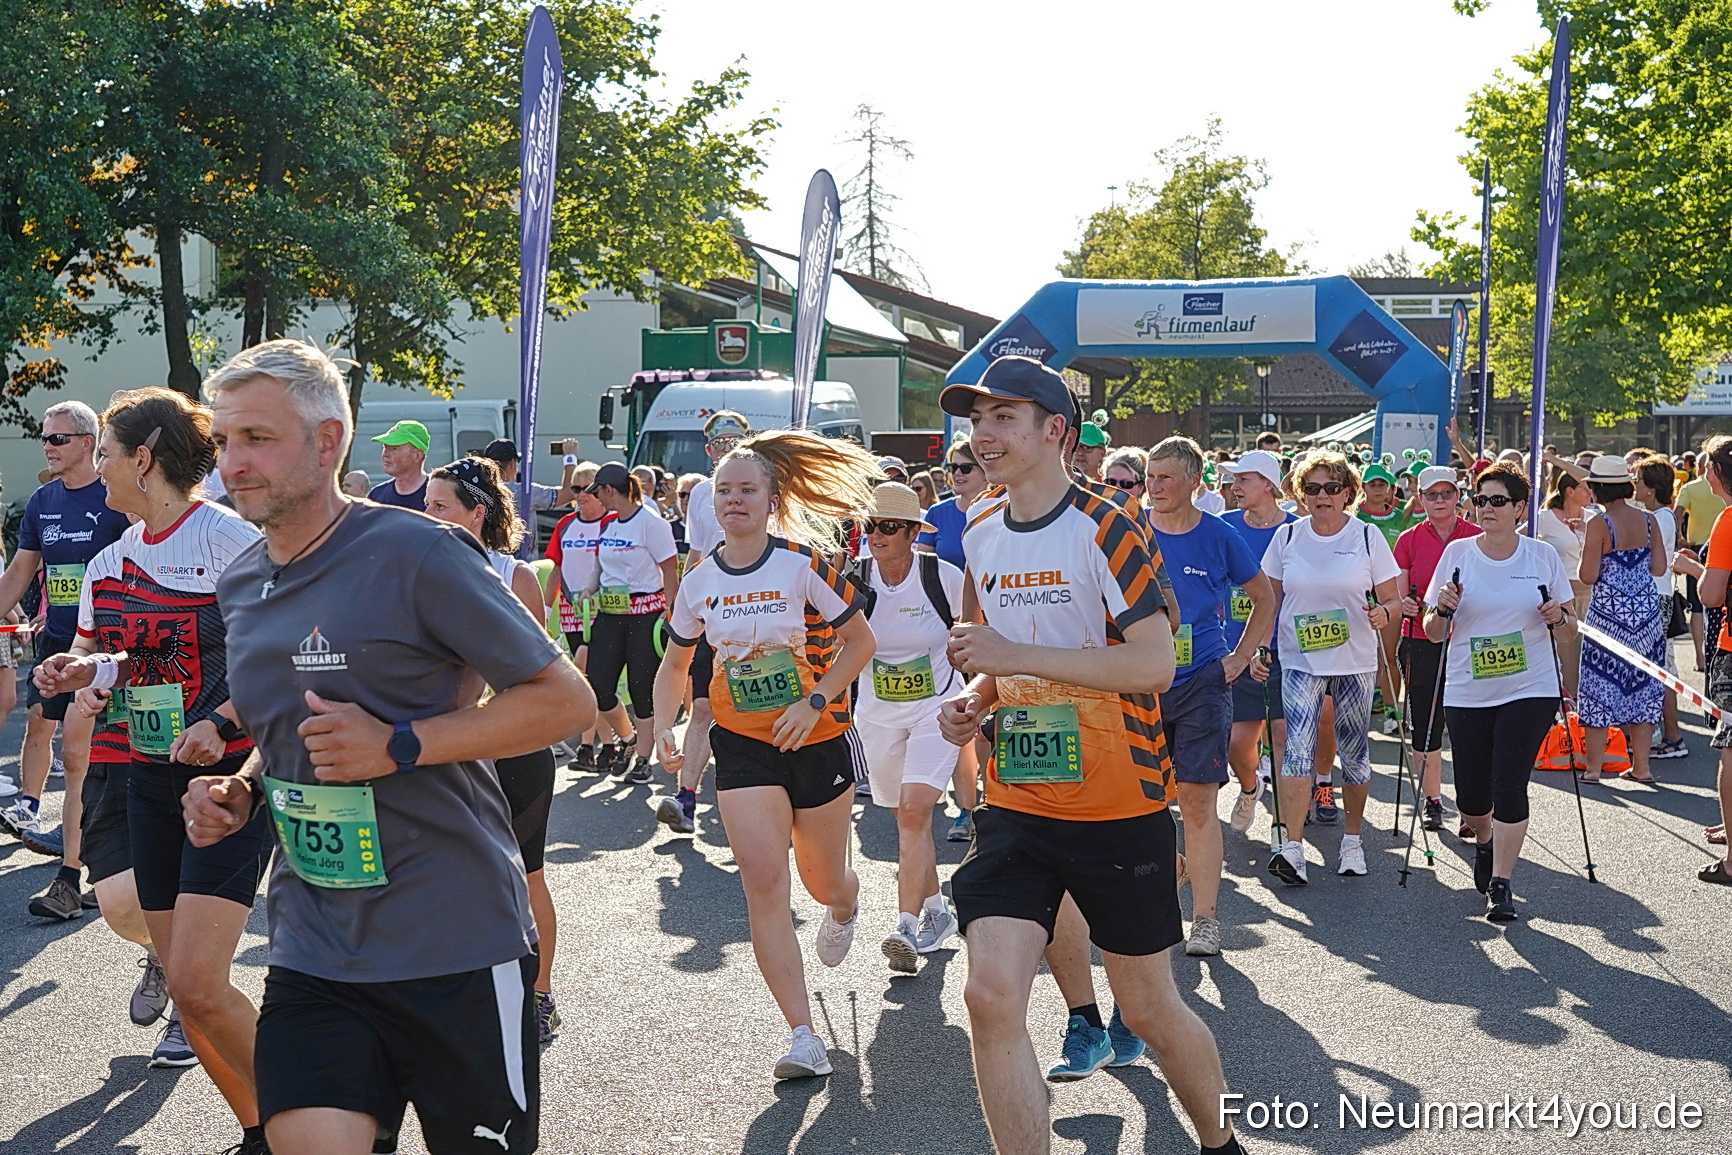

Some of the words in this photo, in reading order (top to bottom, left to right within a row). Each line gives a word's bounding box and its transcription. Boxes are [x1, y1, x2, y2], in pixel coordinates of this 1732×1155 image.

[532, 46, 551, 185] Fischer
[812, 196, 832, 292] Fischer
[1191, 301, 1221, 309] Fischer
[1168, 315, 1257, 333] firmenlauf
[998, 344, 1046, 356] Fischer
[656, 408, 696, 419] abavent
[156, 566, 195, 575] NEUMARKT
[1191, 568, 1208, 576] Berger
[49, 578, 78, 593] 1783
[1000, 570, 1071, 590] KLEBL
[723, 590, 788, 607] KLEBL
[1000, 589, 1072, 608] DYNAMICS
[722, 602, 788, 619] DYNAMICS
[1304, 622, 1341, 640] 1976
[1479, 646, 1518, 665] 1934
[738, 673, 788, 697] 1418
[787, 672, 800, 697] 2022
[882, 673, 924, 690] 1739
[731, 685, 742, 703] RUN
[170, 711, 181, 742] 022
[146, 734, 165, 742] Anita
[1007, 732, 1062, 758] 1051
[1066, 735, 1078, 771] 2022
[1033, 760, 1058, 769] Kilian
[288, 816, 344, 854] 753
[358, 827, 376, 873] 2022
[319, 857, 345, 872] Jörg
